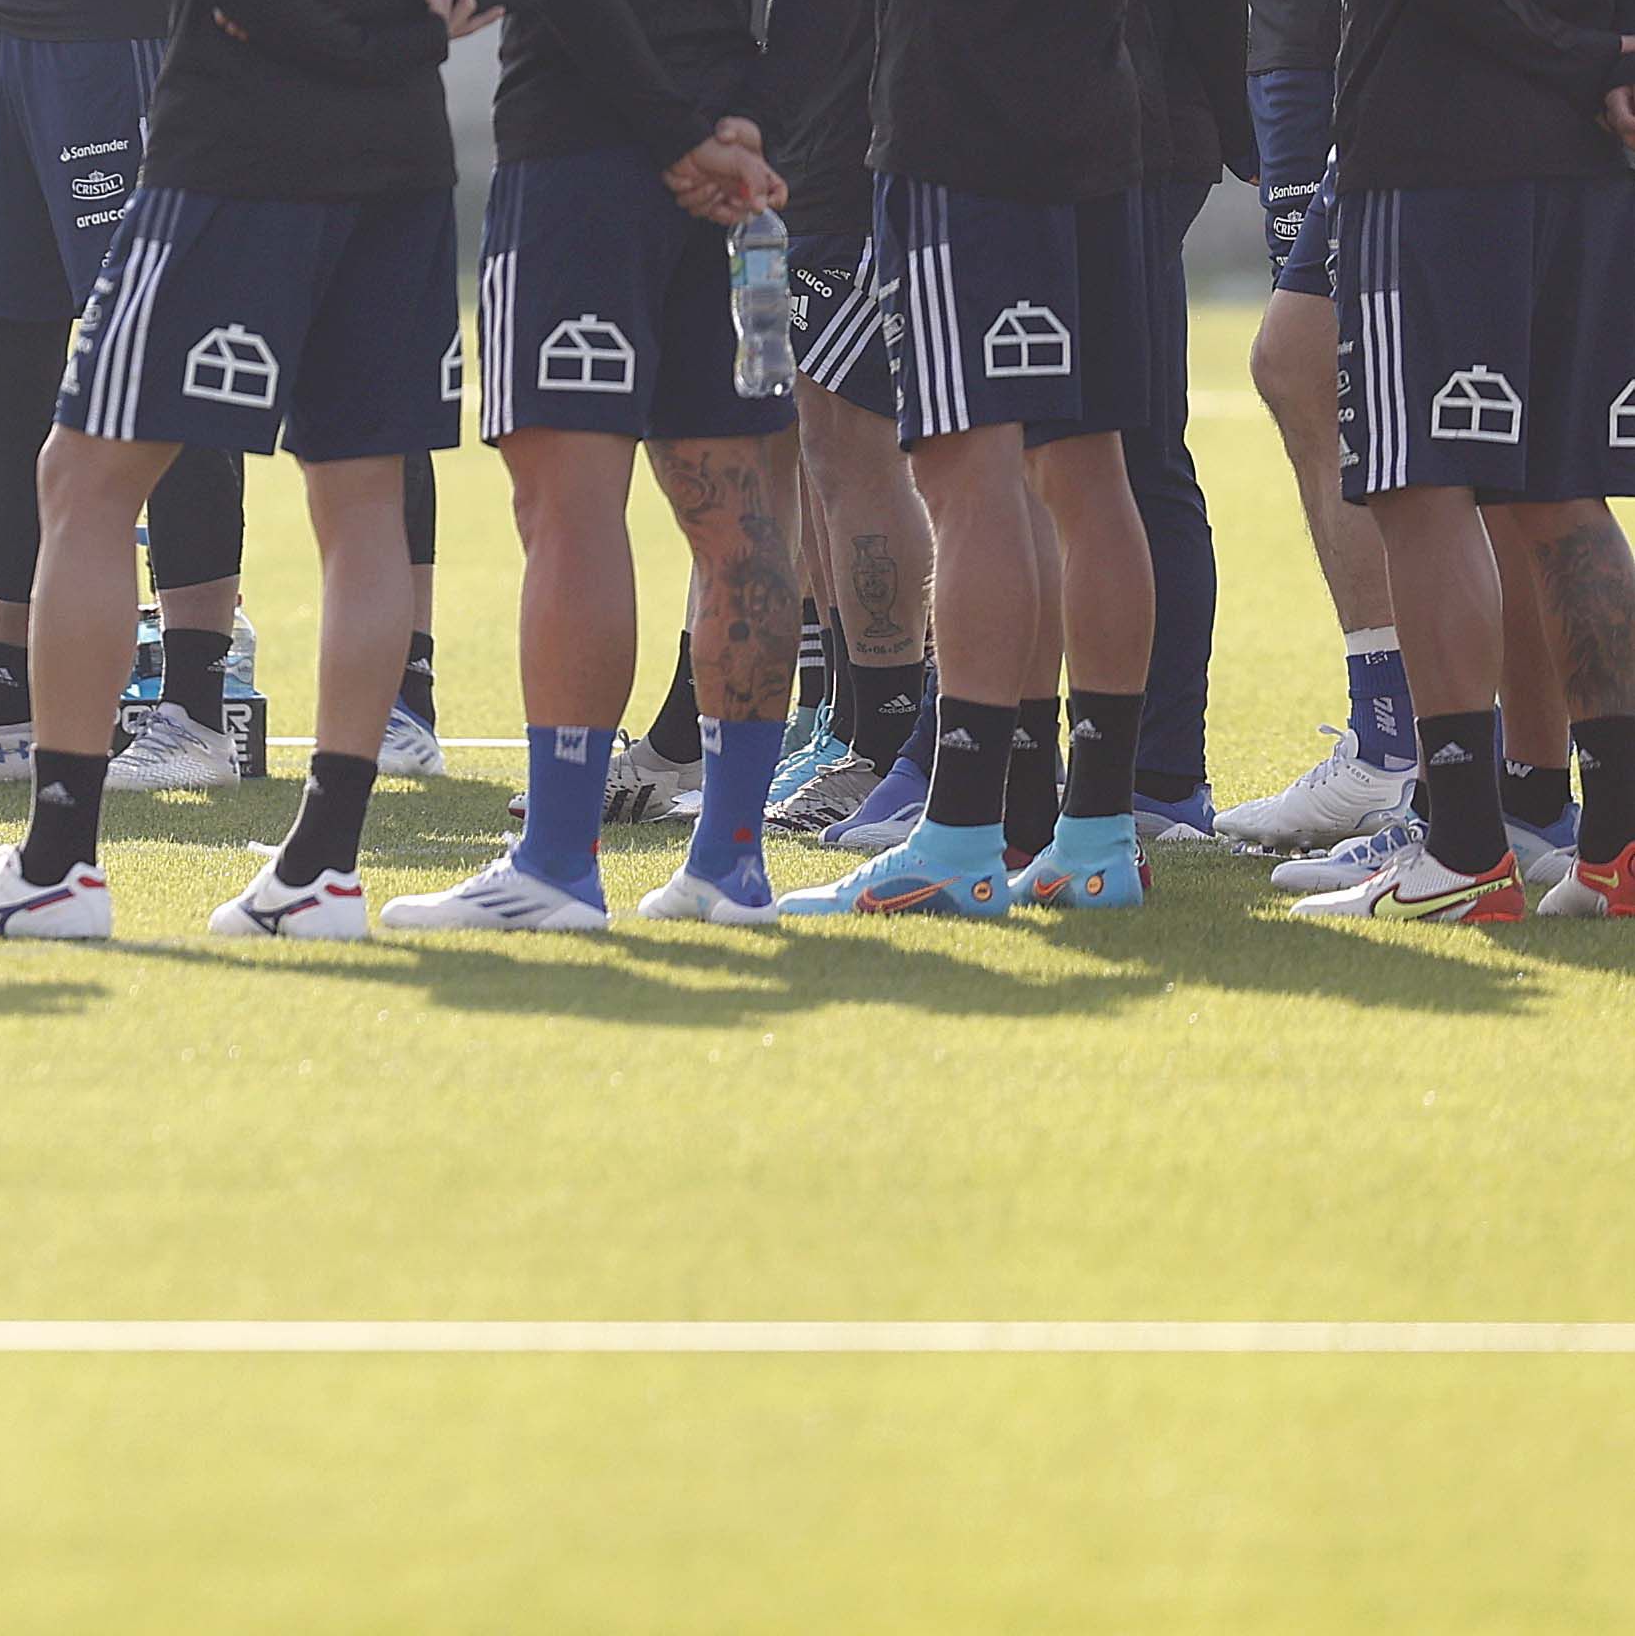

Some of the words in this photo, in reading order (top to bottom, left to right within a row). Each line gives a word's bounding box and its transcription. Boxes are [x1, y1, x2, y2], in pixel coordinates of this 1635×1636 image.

[71, 140, 129, 160] Santander
[75, 179, 119, 195] CRISTAL
[76, 208, 126, 228] arauco
